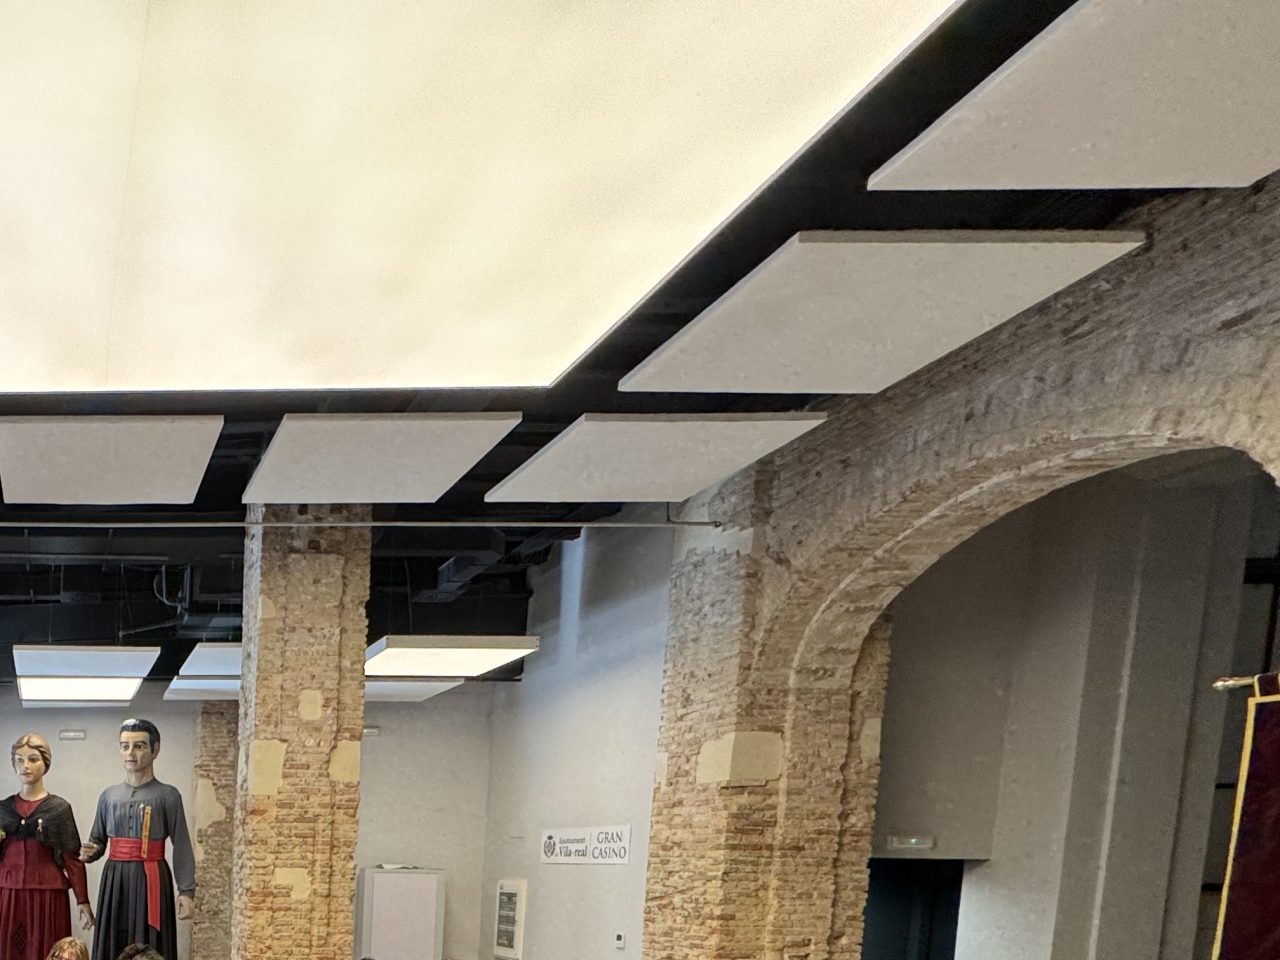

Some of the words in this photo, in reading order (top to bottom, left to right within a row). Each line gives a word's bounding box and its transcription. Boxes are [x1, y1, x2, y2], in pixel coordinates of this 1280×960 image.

[596, 831, 623, 844] GRAN
[559, 845, 588, 857] Vila-real
[591, 846, 627, 859] CASINO
